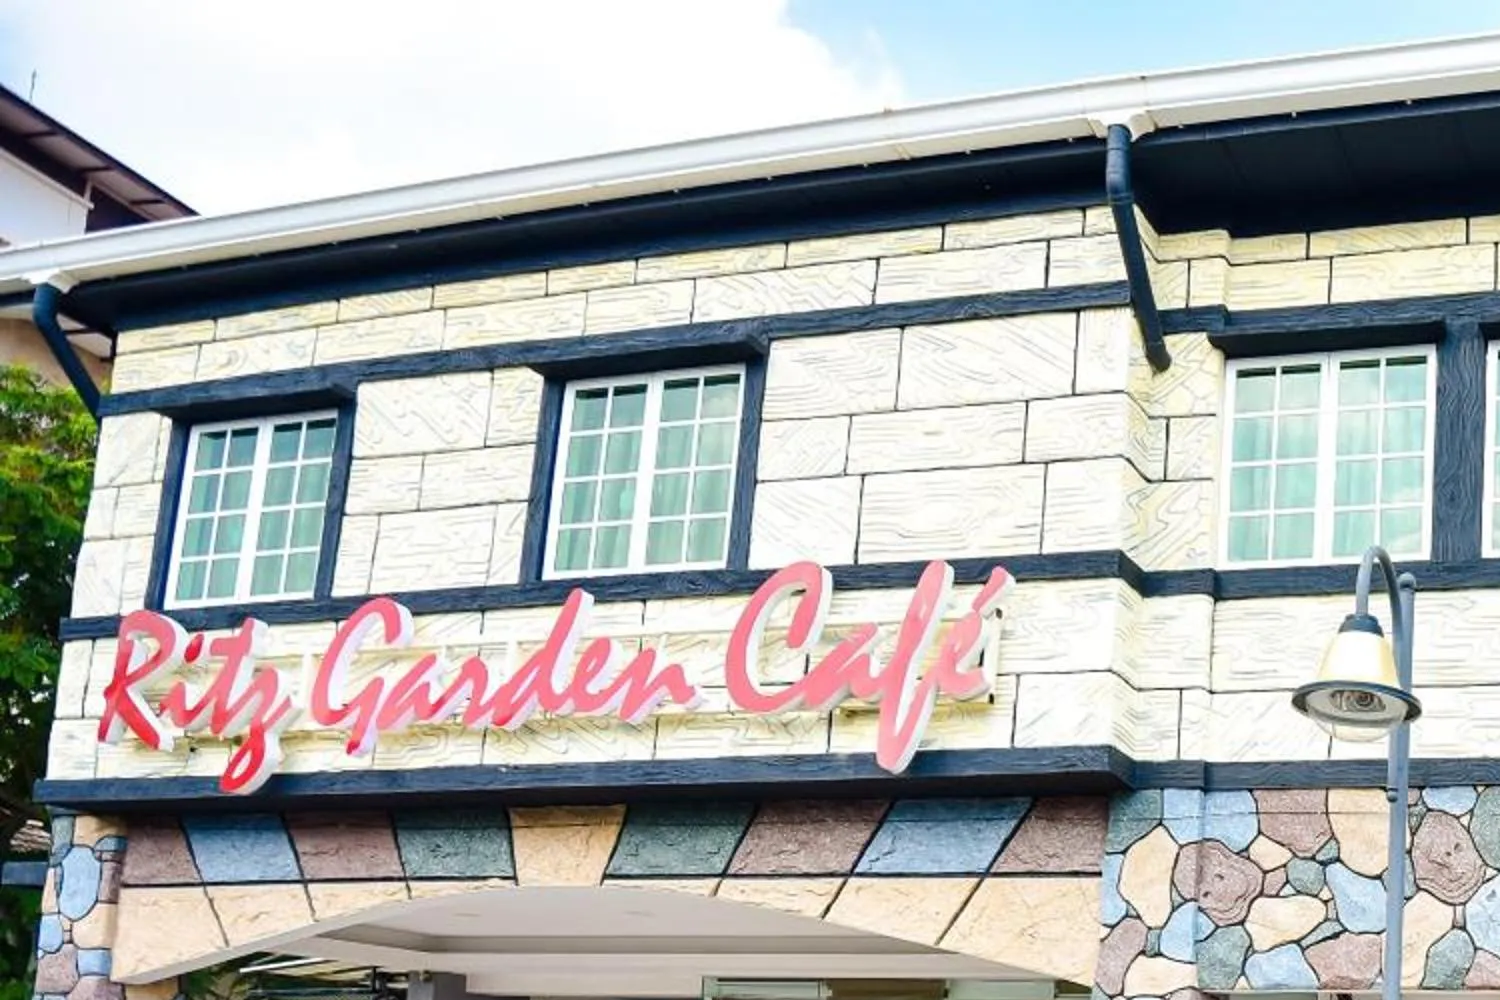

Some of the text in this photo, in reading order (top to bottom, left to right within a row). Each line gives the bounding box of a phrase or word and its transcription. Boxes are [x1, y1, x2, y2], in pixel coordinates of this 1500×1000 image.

[99, 559, 1016, 794] Ritz Garden Café
